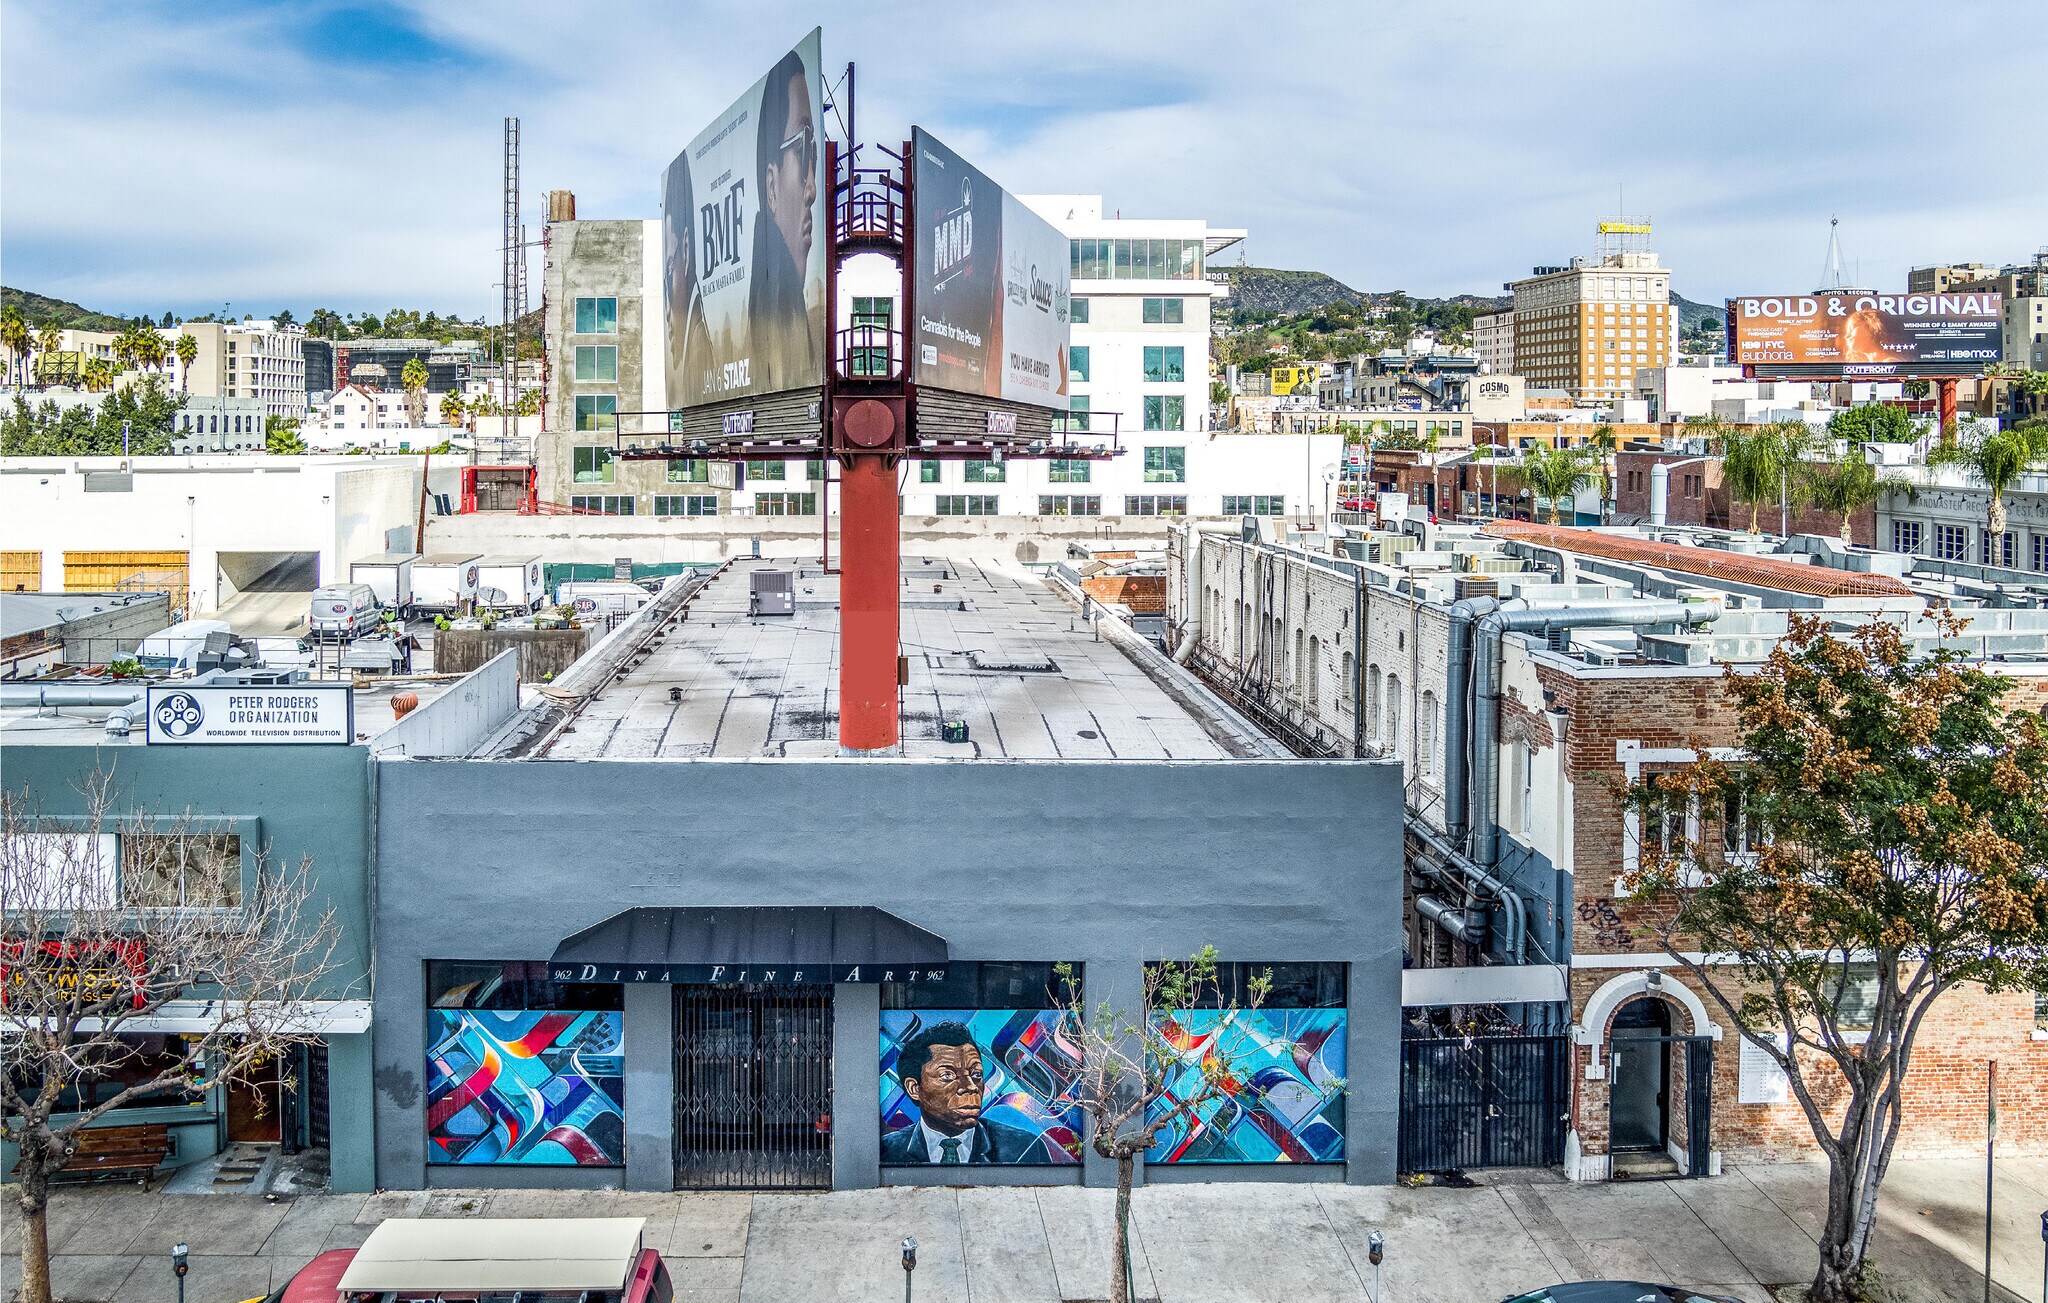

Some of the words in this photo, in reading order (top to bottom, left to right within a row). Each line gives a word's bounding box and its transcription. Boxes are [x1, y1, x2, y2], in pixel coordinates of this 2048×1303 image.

[700, 178, 744, 280] BMF
[934, 210, 972, 276] MMD
[702, 280, 715, 297] BLACK
[716, 274, 730, 291] MAFIA
[729, 265, 746, 285] FAMILY
[1827, 297, 1846, 316] &
[921, 315, 948, 337] Cannabis
[948, 322, 956, 340] for
[956, 327, 964, 342] the
[964, 329, 981, 348] People
[1742, 340, 1761, 349] HBO
[1765, 340, 1785, 348] FYC
[1742, 348, 1794, 362] euphoria
[1010, 352, 1020, 370] YOU
[1020, 356, 1032, 375] HAVE
[1032, 360, 1050, 378] ARRIVED
[703, 368, 716, 394] JAN
[717, 368, 721, 392] 6
[723, 358, 751, 390] STARZ
[1480, 382, 1509, 394] COSMO
[1966, 501, 2012, 516] RECOS
[2016, 504, 2034, 518] EST.
[230, 696, 263, 709] PETER
[268, 696, 318, 709] RODGERS
[230, 711, 318, 723] ORGANIZATION
[16, 972, 121, 988] HLYWOOD
[554, 970, 573, 980] 962
[926, 970, 945, 981] 962
